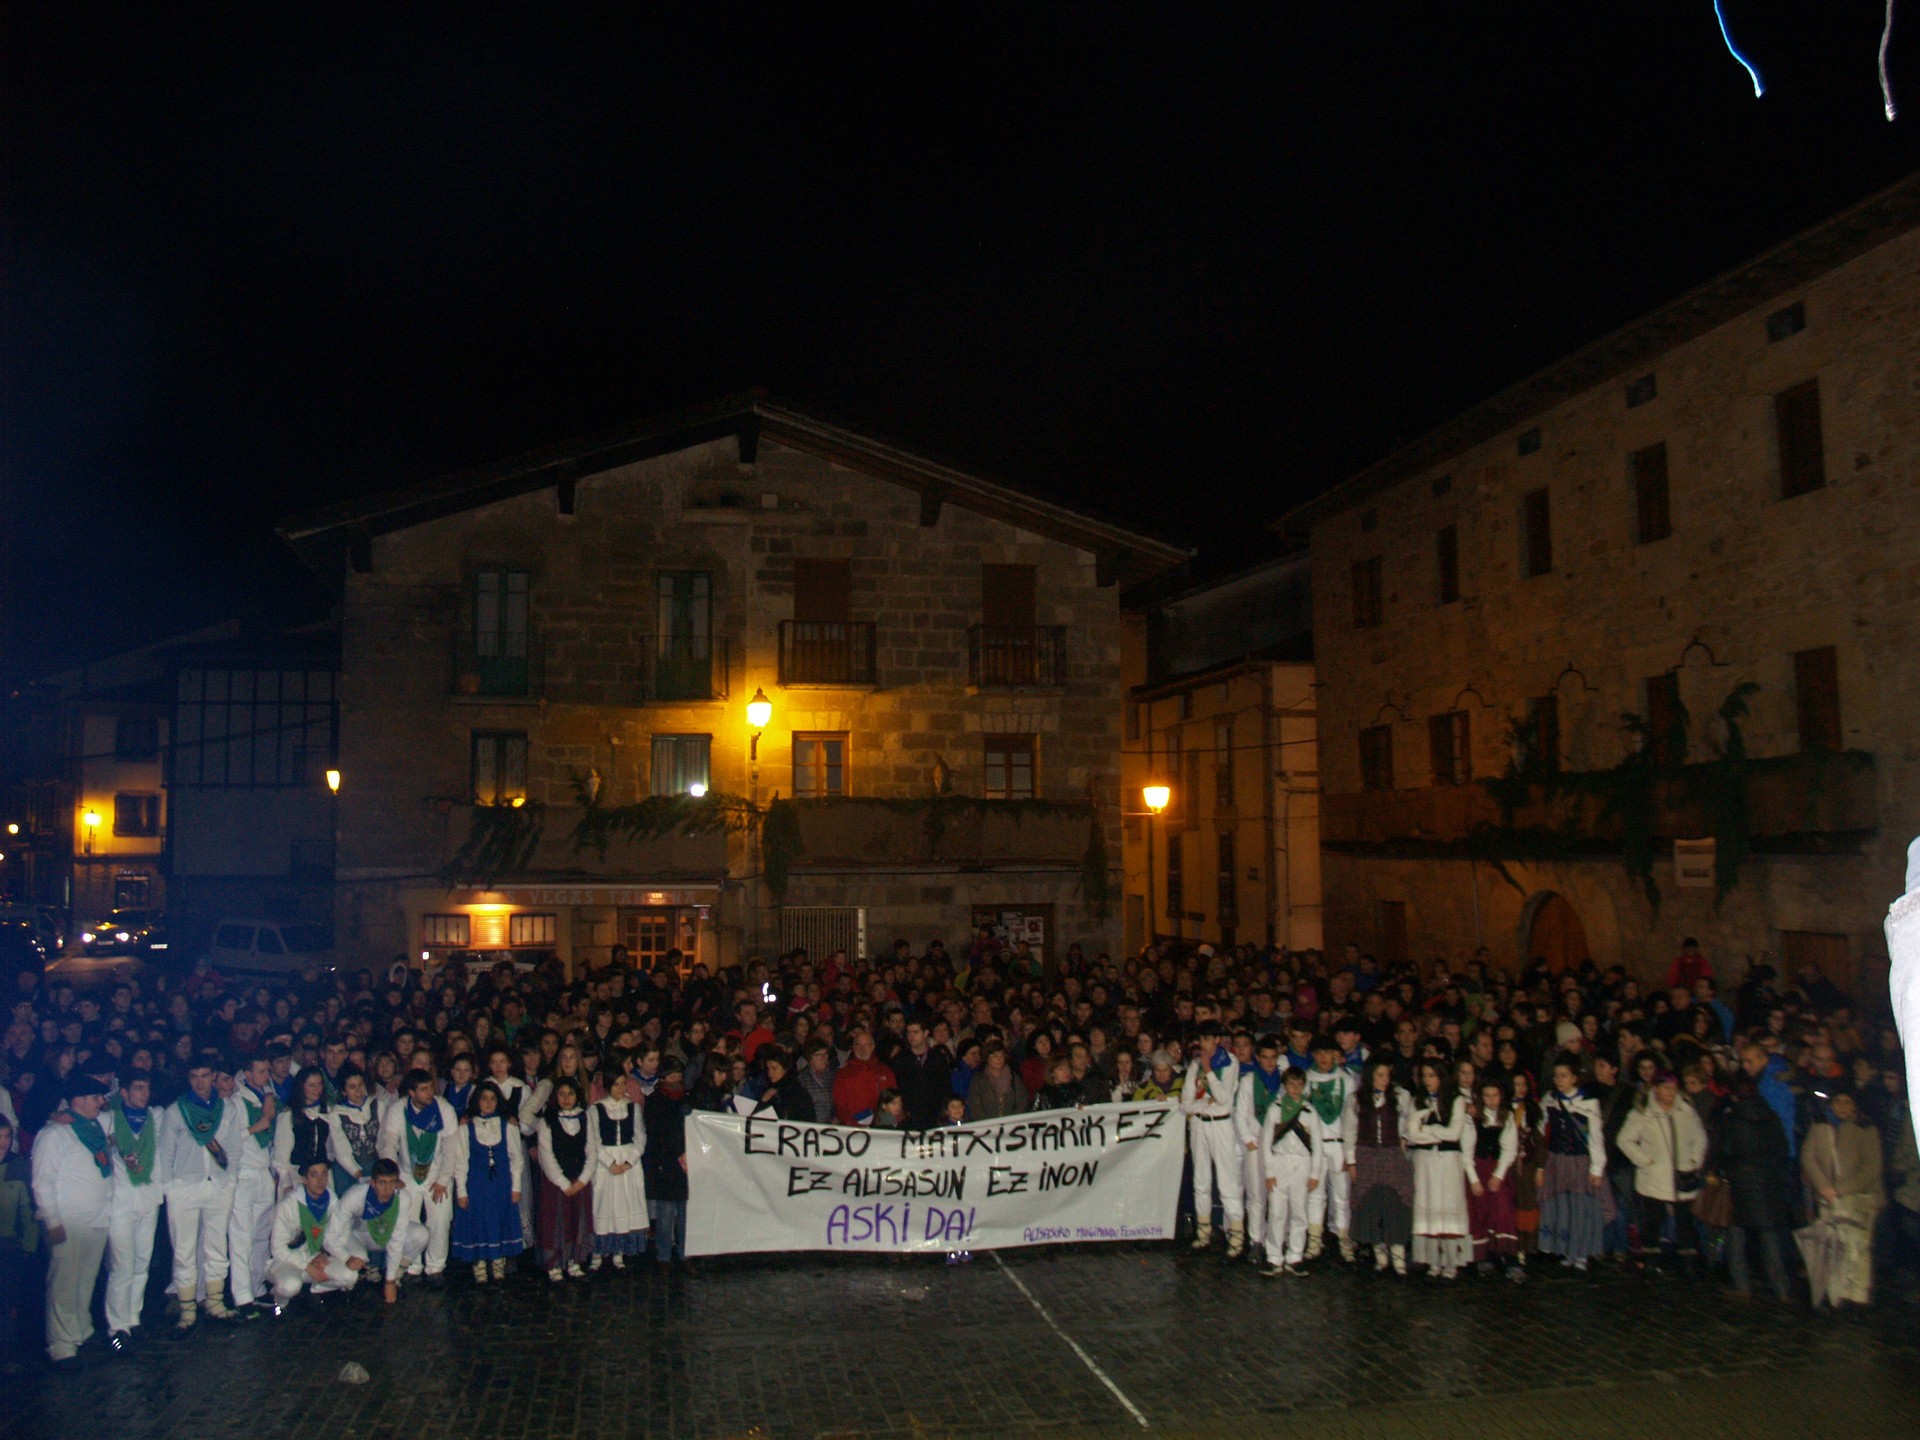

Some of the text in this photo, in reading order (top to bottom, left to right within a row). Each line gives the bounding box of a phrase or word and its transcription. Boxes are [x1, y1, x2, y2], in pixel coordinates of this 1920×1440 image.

[530, 889, 594, 905] VEGAS
[745, 1115, 871, 1158] ERASO
[1115, 1109, 1171, 1144] EZ
[787, 1166, 833, 1197] EZ
[842, 1165, 967, 1201] ALTSASUN
[986, 1166, 1030, 1198] EZ
[924, 1206, 976, 1243] DA!
